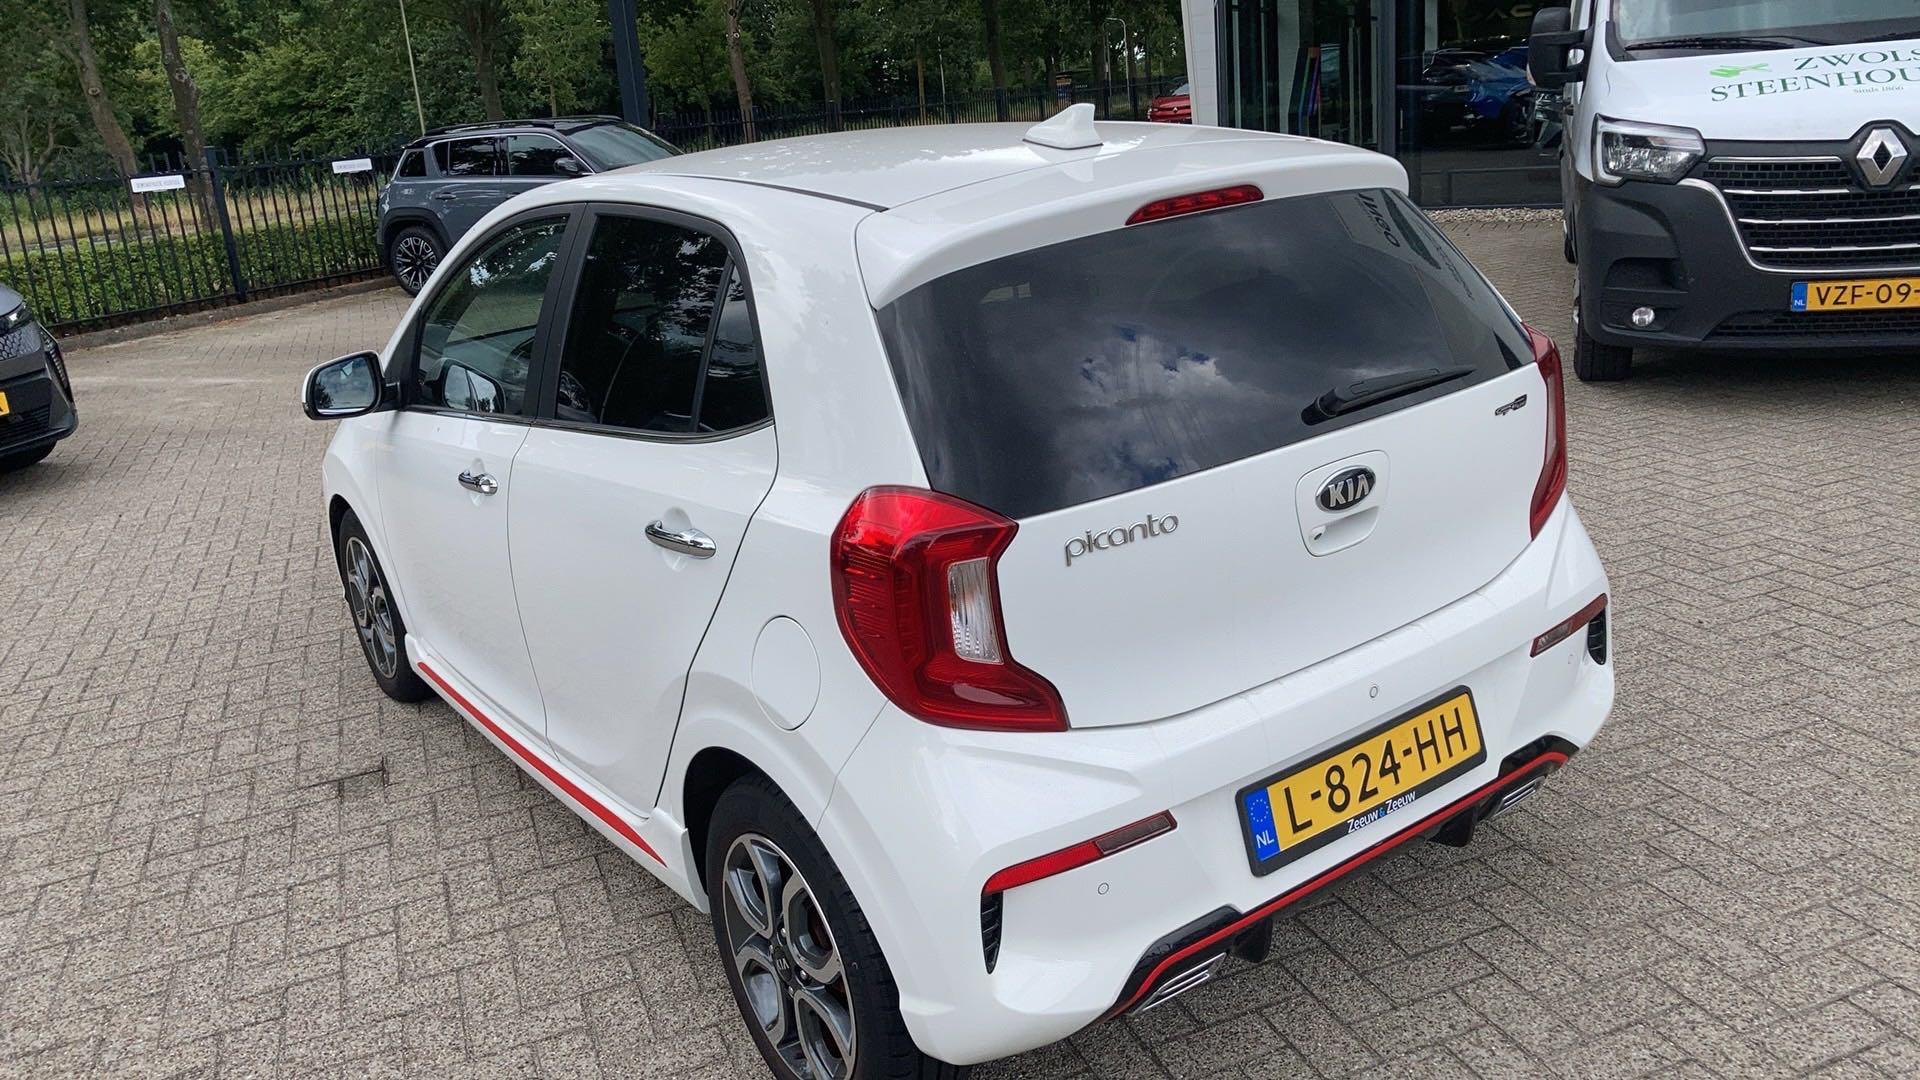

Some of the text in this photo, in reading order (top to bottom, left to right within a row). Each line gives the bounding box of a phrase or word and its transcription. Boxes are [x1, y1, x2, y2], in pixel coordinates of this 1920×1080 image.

[1711, 67, 1920, 102] STEENHOU
[1327, 473, 1371, 508] KIA
[1063, 512, 1180, 567] picanto
[1283, 706, 1468, 835] L-824-HH
[1347, 809, 1379, 834] Zeeuw
[1385, 791, 1416, 815] Zeeuw
[1255, 832, 1275, 849] NL
